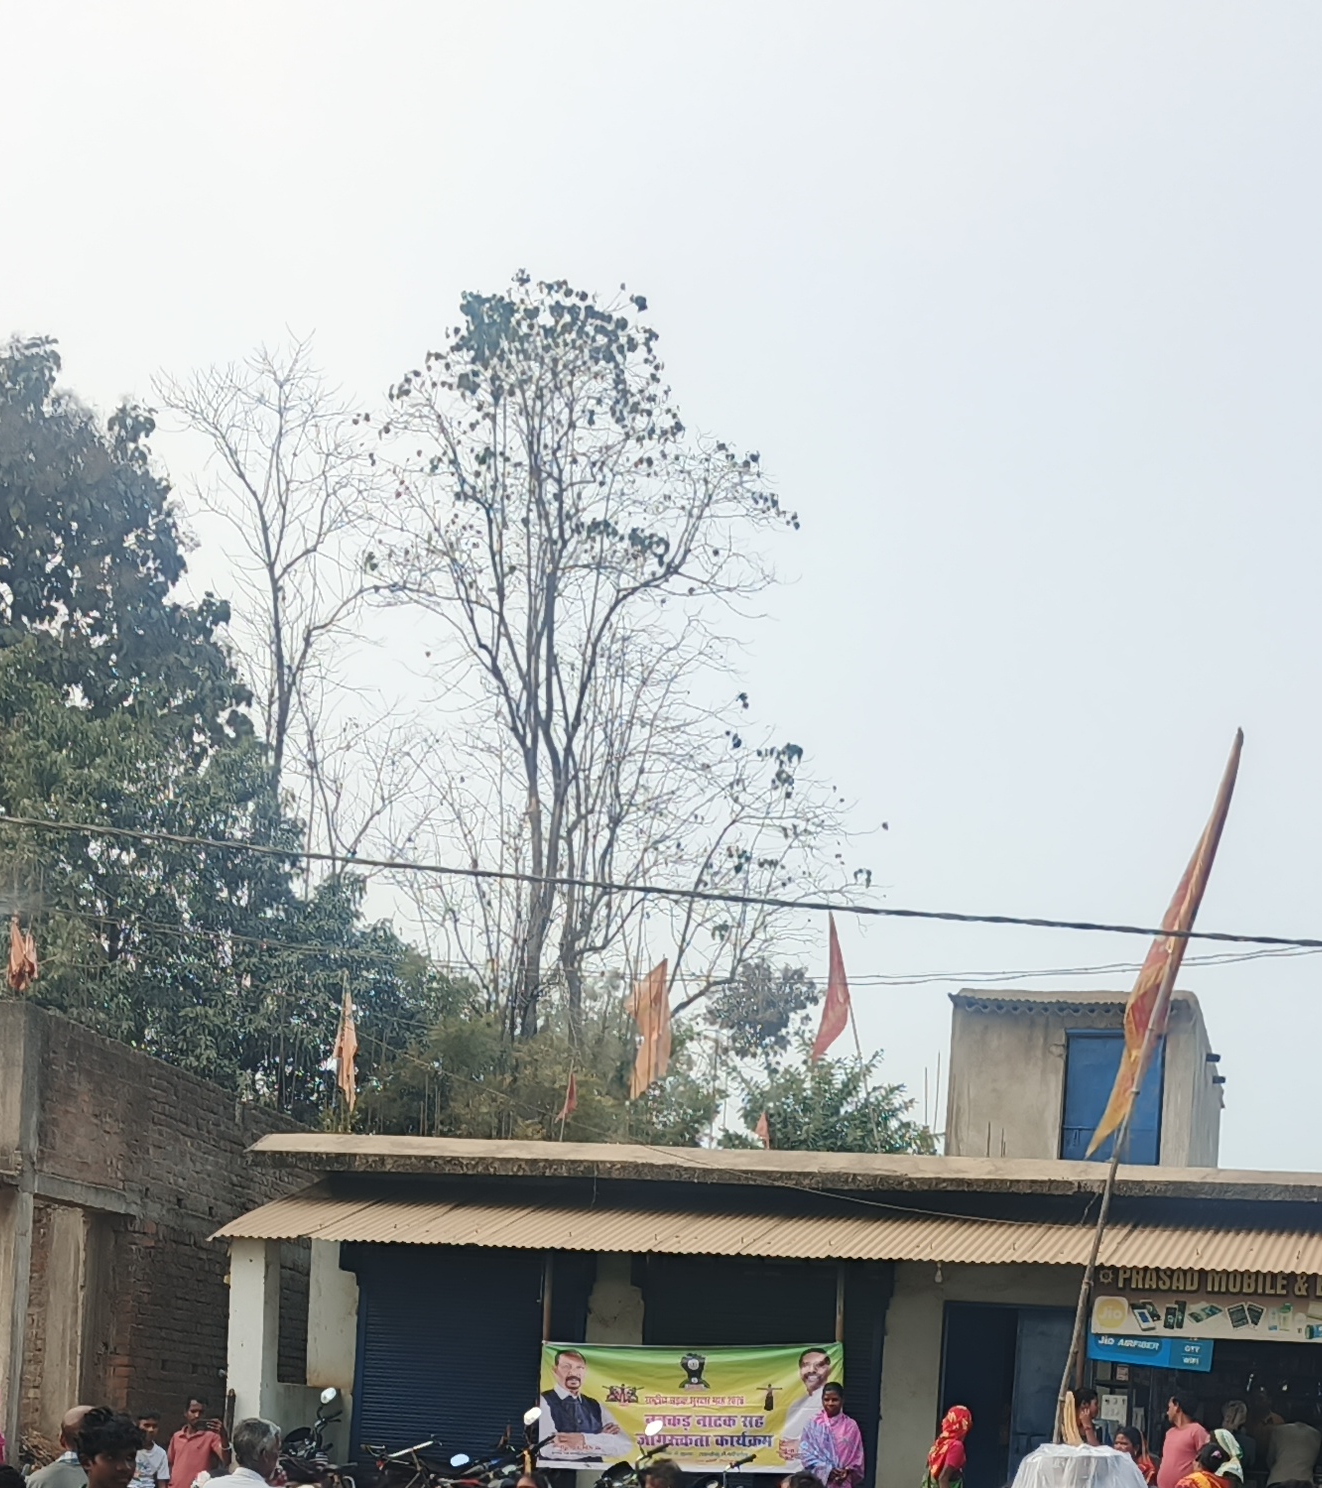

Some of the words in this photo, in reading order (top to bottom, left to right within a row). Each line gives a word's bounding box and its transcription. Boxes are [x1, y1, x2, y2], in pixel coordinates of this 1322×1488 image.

[1117, 1267, 1199, 1292] PRASAD
[1207, 1270, 1287, 1296] MOBILE
[1295, 1277, 1309, 1296] &
[1099, 1305, 1122, 1320] Jio
[695, 1414, 738, 1429] नाटक
[714, 1431, 775, 1448] कार्यक्रम
